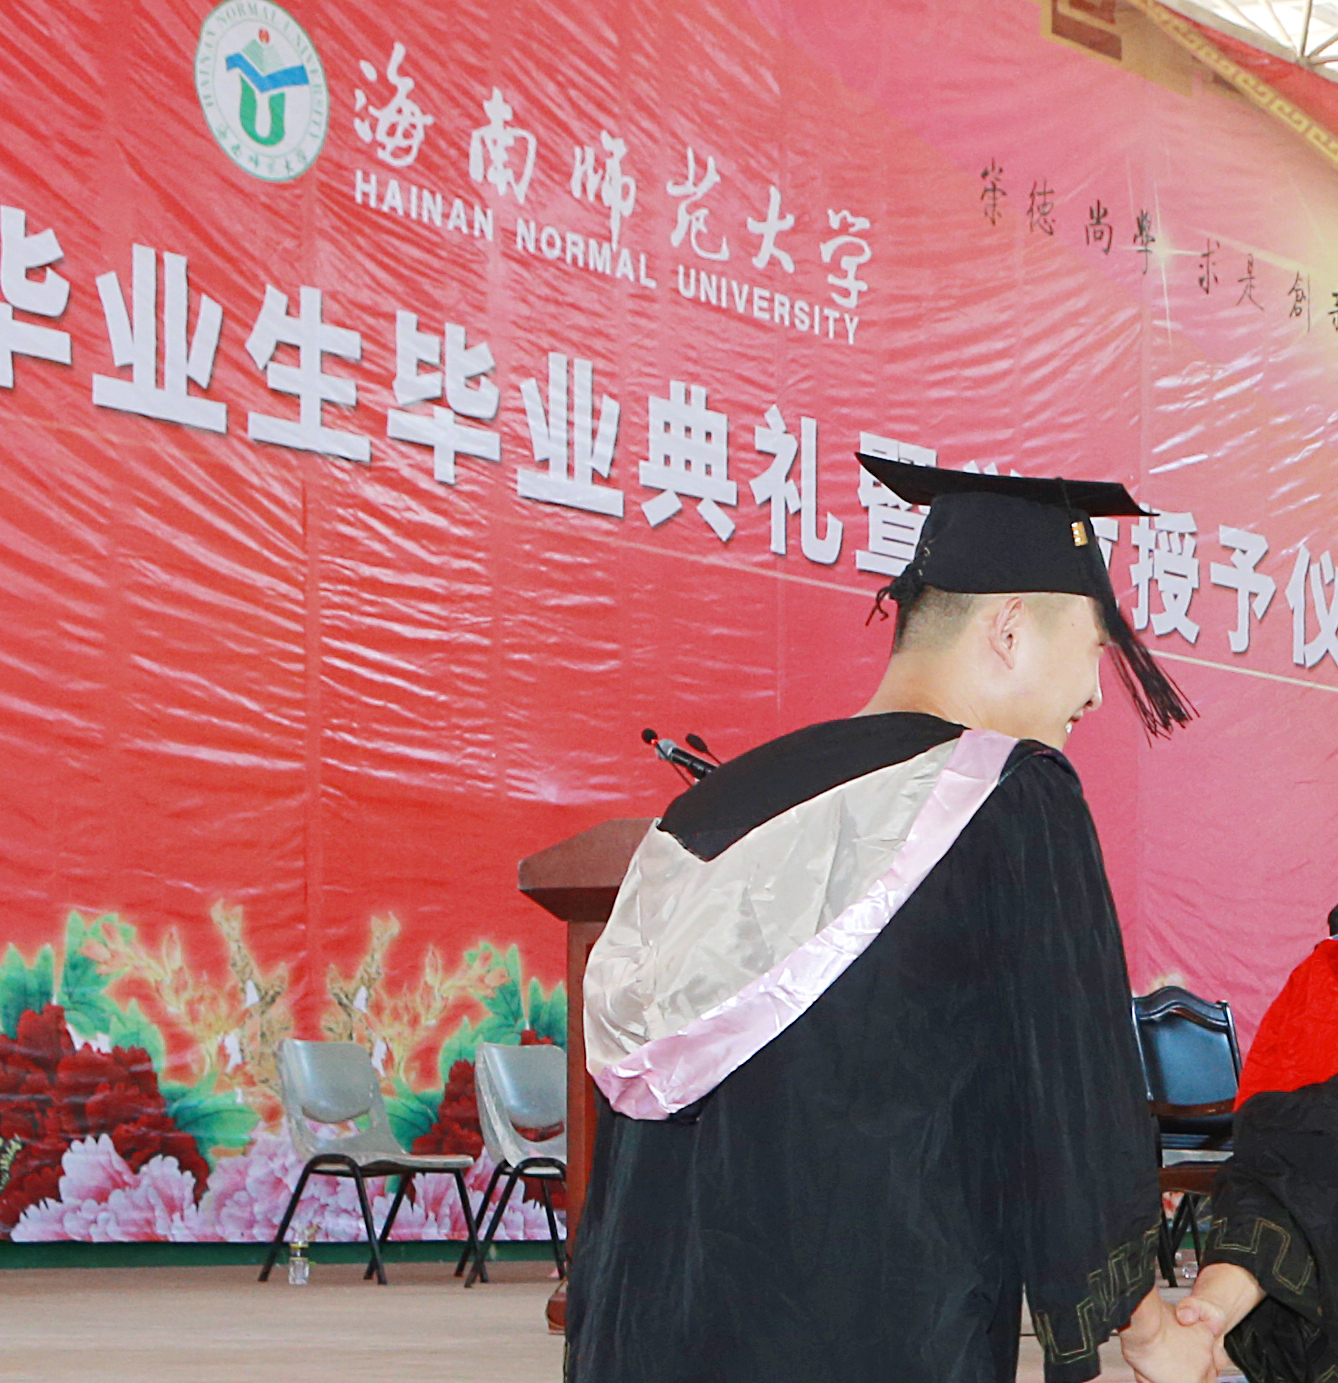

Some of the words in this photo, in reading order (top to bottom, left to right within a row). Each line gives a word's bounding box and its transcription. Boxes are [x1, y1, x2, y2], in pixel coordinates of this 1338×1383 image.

[354, 41, 872, 308] 海南师范大学
[355, 169, 494, 241] HAINAN
[515, 218, 657, 288] NORMAL
[677, 265, 861, 345] UNIVERSITY
